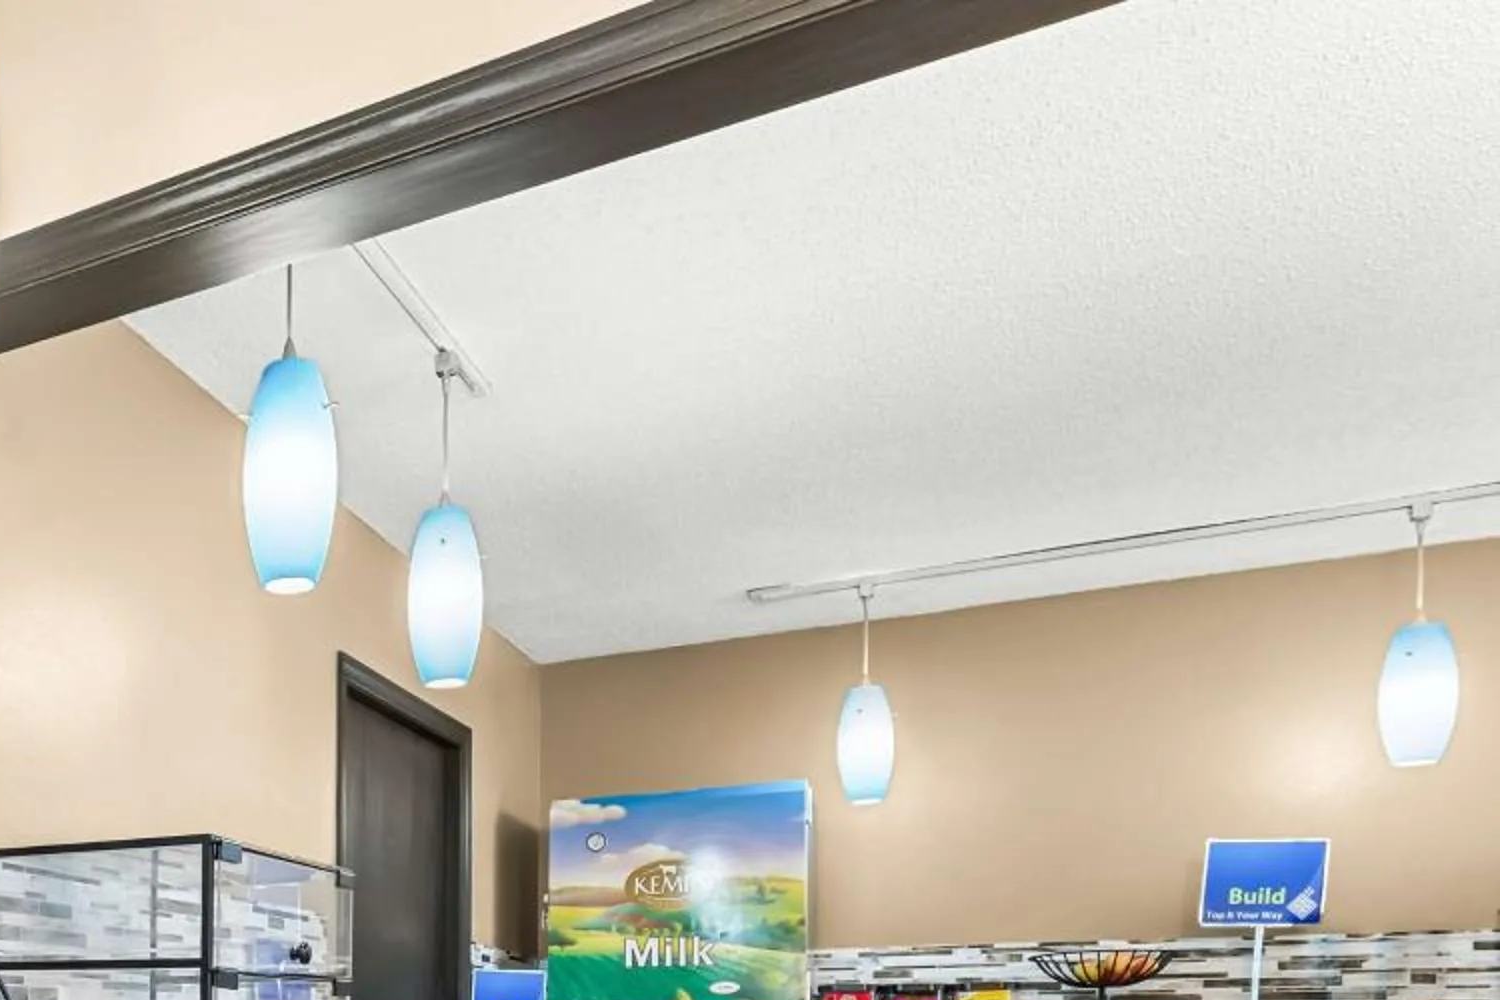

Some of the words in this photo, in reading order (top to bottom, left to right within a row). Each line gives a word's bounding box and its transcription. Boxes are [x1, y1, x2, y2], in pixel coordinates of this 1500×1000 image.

[635, 873, 705, 896] KEM
[1229, 886, 1287, 905] Build
[624, 935, 715, 969] Milk
